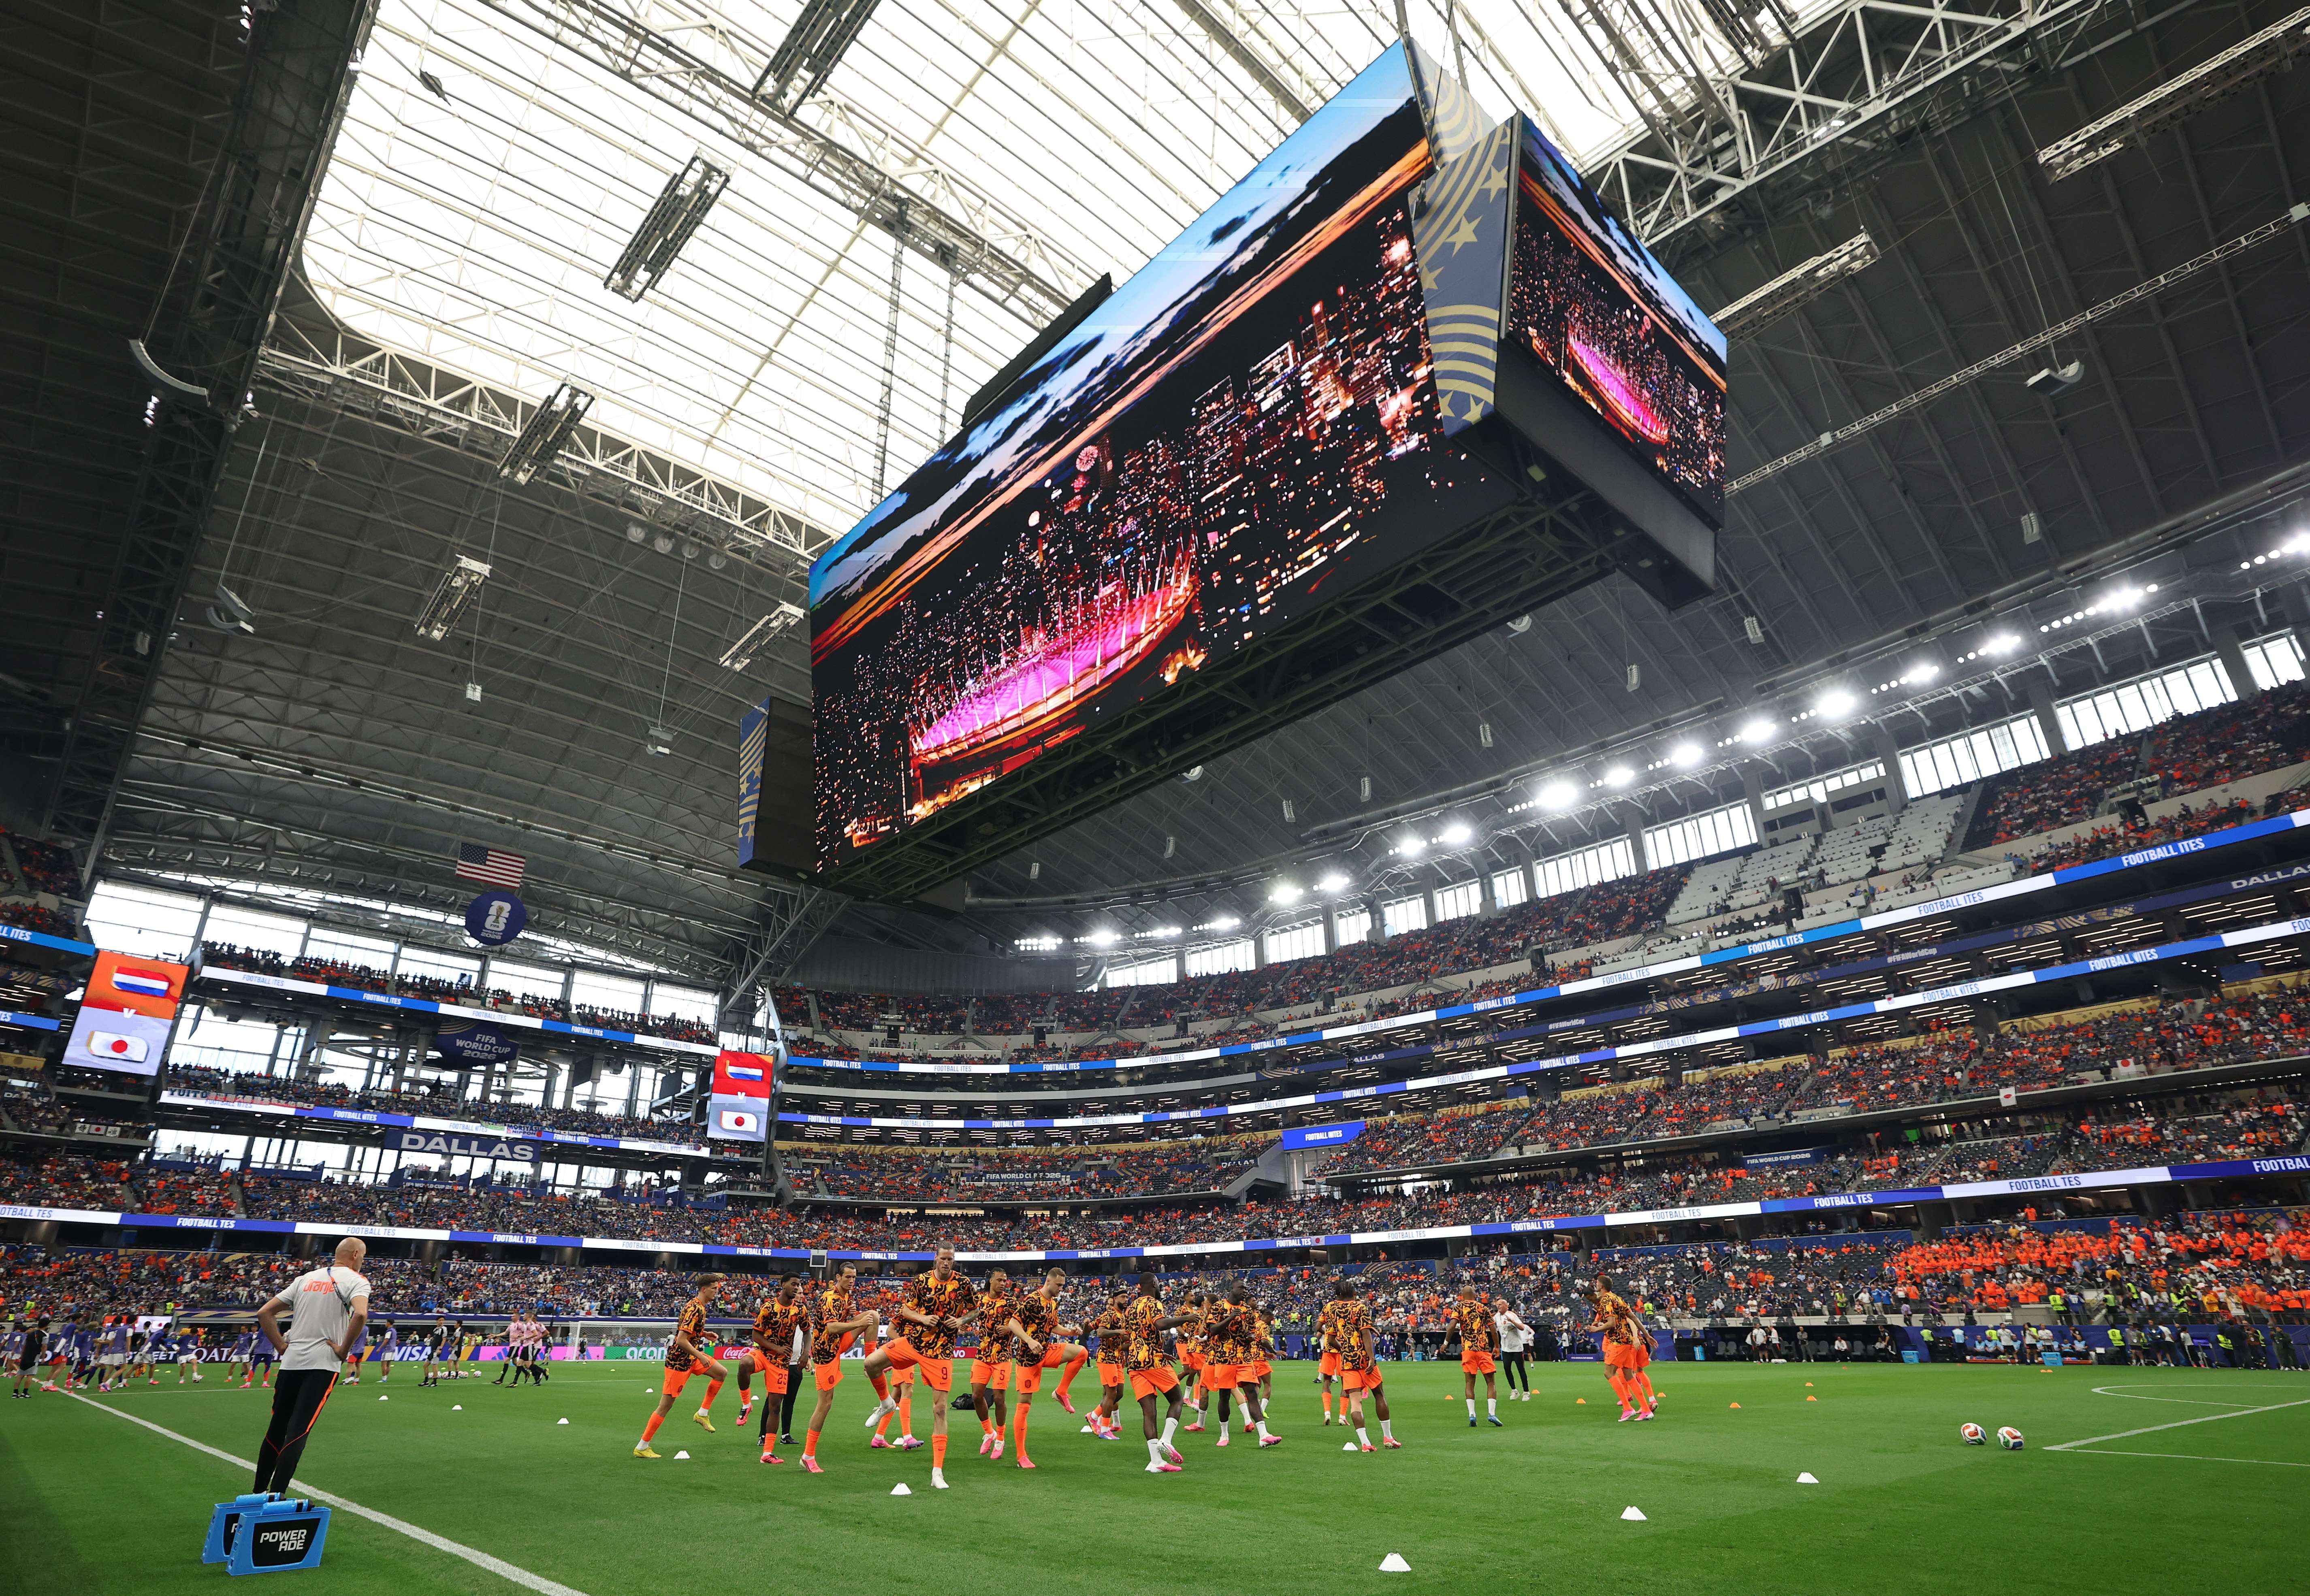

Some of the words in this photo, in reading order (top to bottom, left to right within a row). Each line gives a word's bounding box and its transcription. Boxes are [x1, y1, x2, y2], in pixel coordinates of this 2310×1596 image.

[2121, 844, 2178, 867] FOOTBALL
[1918, 897, 1962, 915] FOOTBALL
[1748, 938, 1784, 955] FOOTBALL
[1887, 947, 1937, 964] #FIFAWorldCup
[2088, 954, 2134, 971] FOOTBALL
[242, 974, 271, 985] FOOTBALL
[1603, 971, 1633, 985] FOOTBALL
[363, 993, 390, 1004] FOOTBALL
[1922, 989, 1958, 1002] FOOTBALL
[1473, 998, 1502, 1012] FOOTBALL
[472, 1011, 496, 1020] FOOTBALL
[1358, 1021, 1382, 1032] FOOTBALL
[1778, 1016, 1810, 1029] FOOTBALL
[571, 1026, 592, 1036] FOOTBALL
[476, 1034, 496, 1044] FIFA
[662, 1040, 682, 1048] FOOTBALL
[1653, 1038, 1681, 1050] FOOTBALL
[456, 1039, 491, 1052] WORLD
[492, 1043, 511, 1053] CUP
[1251, 1040, 1275, 1051] FOOTBALL
[463, 1050, 497, 1060] 2026
[1149, 1055, 1173, 1063] FOOTBALL
[1353, 1053, 1385, 1062] ALLAS
[823, 1059, 848, 1068] FOOTBALL
[1043, 1063, 1067, 1071] FOOTBALL
[1539, 1057, 1566, 1069] FOOTBALL
[1437, 1074, 1460, 1084] FOOTBALL
[169, 1088, 208, 1098] YUITO
[1342, 1089, 1363, 1099] FOOTBALL
[1255, 1101, 1274, 1110] FOOTBALL
[333, 1110, 361, 1120] FOOTBALL
[808, 1115, 829, 1123] FOOTBALL
[1169, 1111, 1190, 1119] FOOTBALL
[449, 1122, 474, 1131] FOOTBALL
[553, 1134, 576, 1142] FOOTBALL
[1305, 1132, 1328, 1141] FOOTBALL
[401, 1134, 534, 1161] DALLAS
[2252, 1157, 2310, 1172] FOOTBAL
[2009, 1177, 2060, 1191] FOOTBALL
[2062, 1176, 2081, 1187] TES
[1814, 1195, 1856, 1208] FOOTBALL
[1856, 1193, 1873, 1204] TES
[36, 1210, 52, 1218] TES
[1652, 1210, 1687, 1220] FOOTBALL
[1688, 1208, 1701, 1217] TES
[177, 1217, 218, 1227] FOOTBALL
[219, 1219, 235, 1229] TES
[1511, 1221, 1542, 1232] FOOTBALL
[1542, 1220, 1555, 1229] TES
[346, 1227, 382, 1236] FOOTBALL
[1388, 1232, 1415, 1240] FOOTBALL
[493, 1234, 524, 1243] FOOTBALL
[525, 1236, 537, 1244] TES
[1276, 1239, 1300, 1248] FOOTBALL
[1300, 1238, 1311, 1246] TES
[736, 1247, 761, 1255] FOOTBALL
[393, 1347, 431, 1361] VISA
[941, 1367, 948, 1380] 9
[1000, 1370, 1005, 1380] 5
[260, 1529, 307, 1543] POWER
[278, 1540, 305, 1551] ADE
